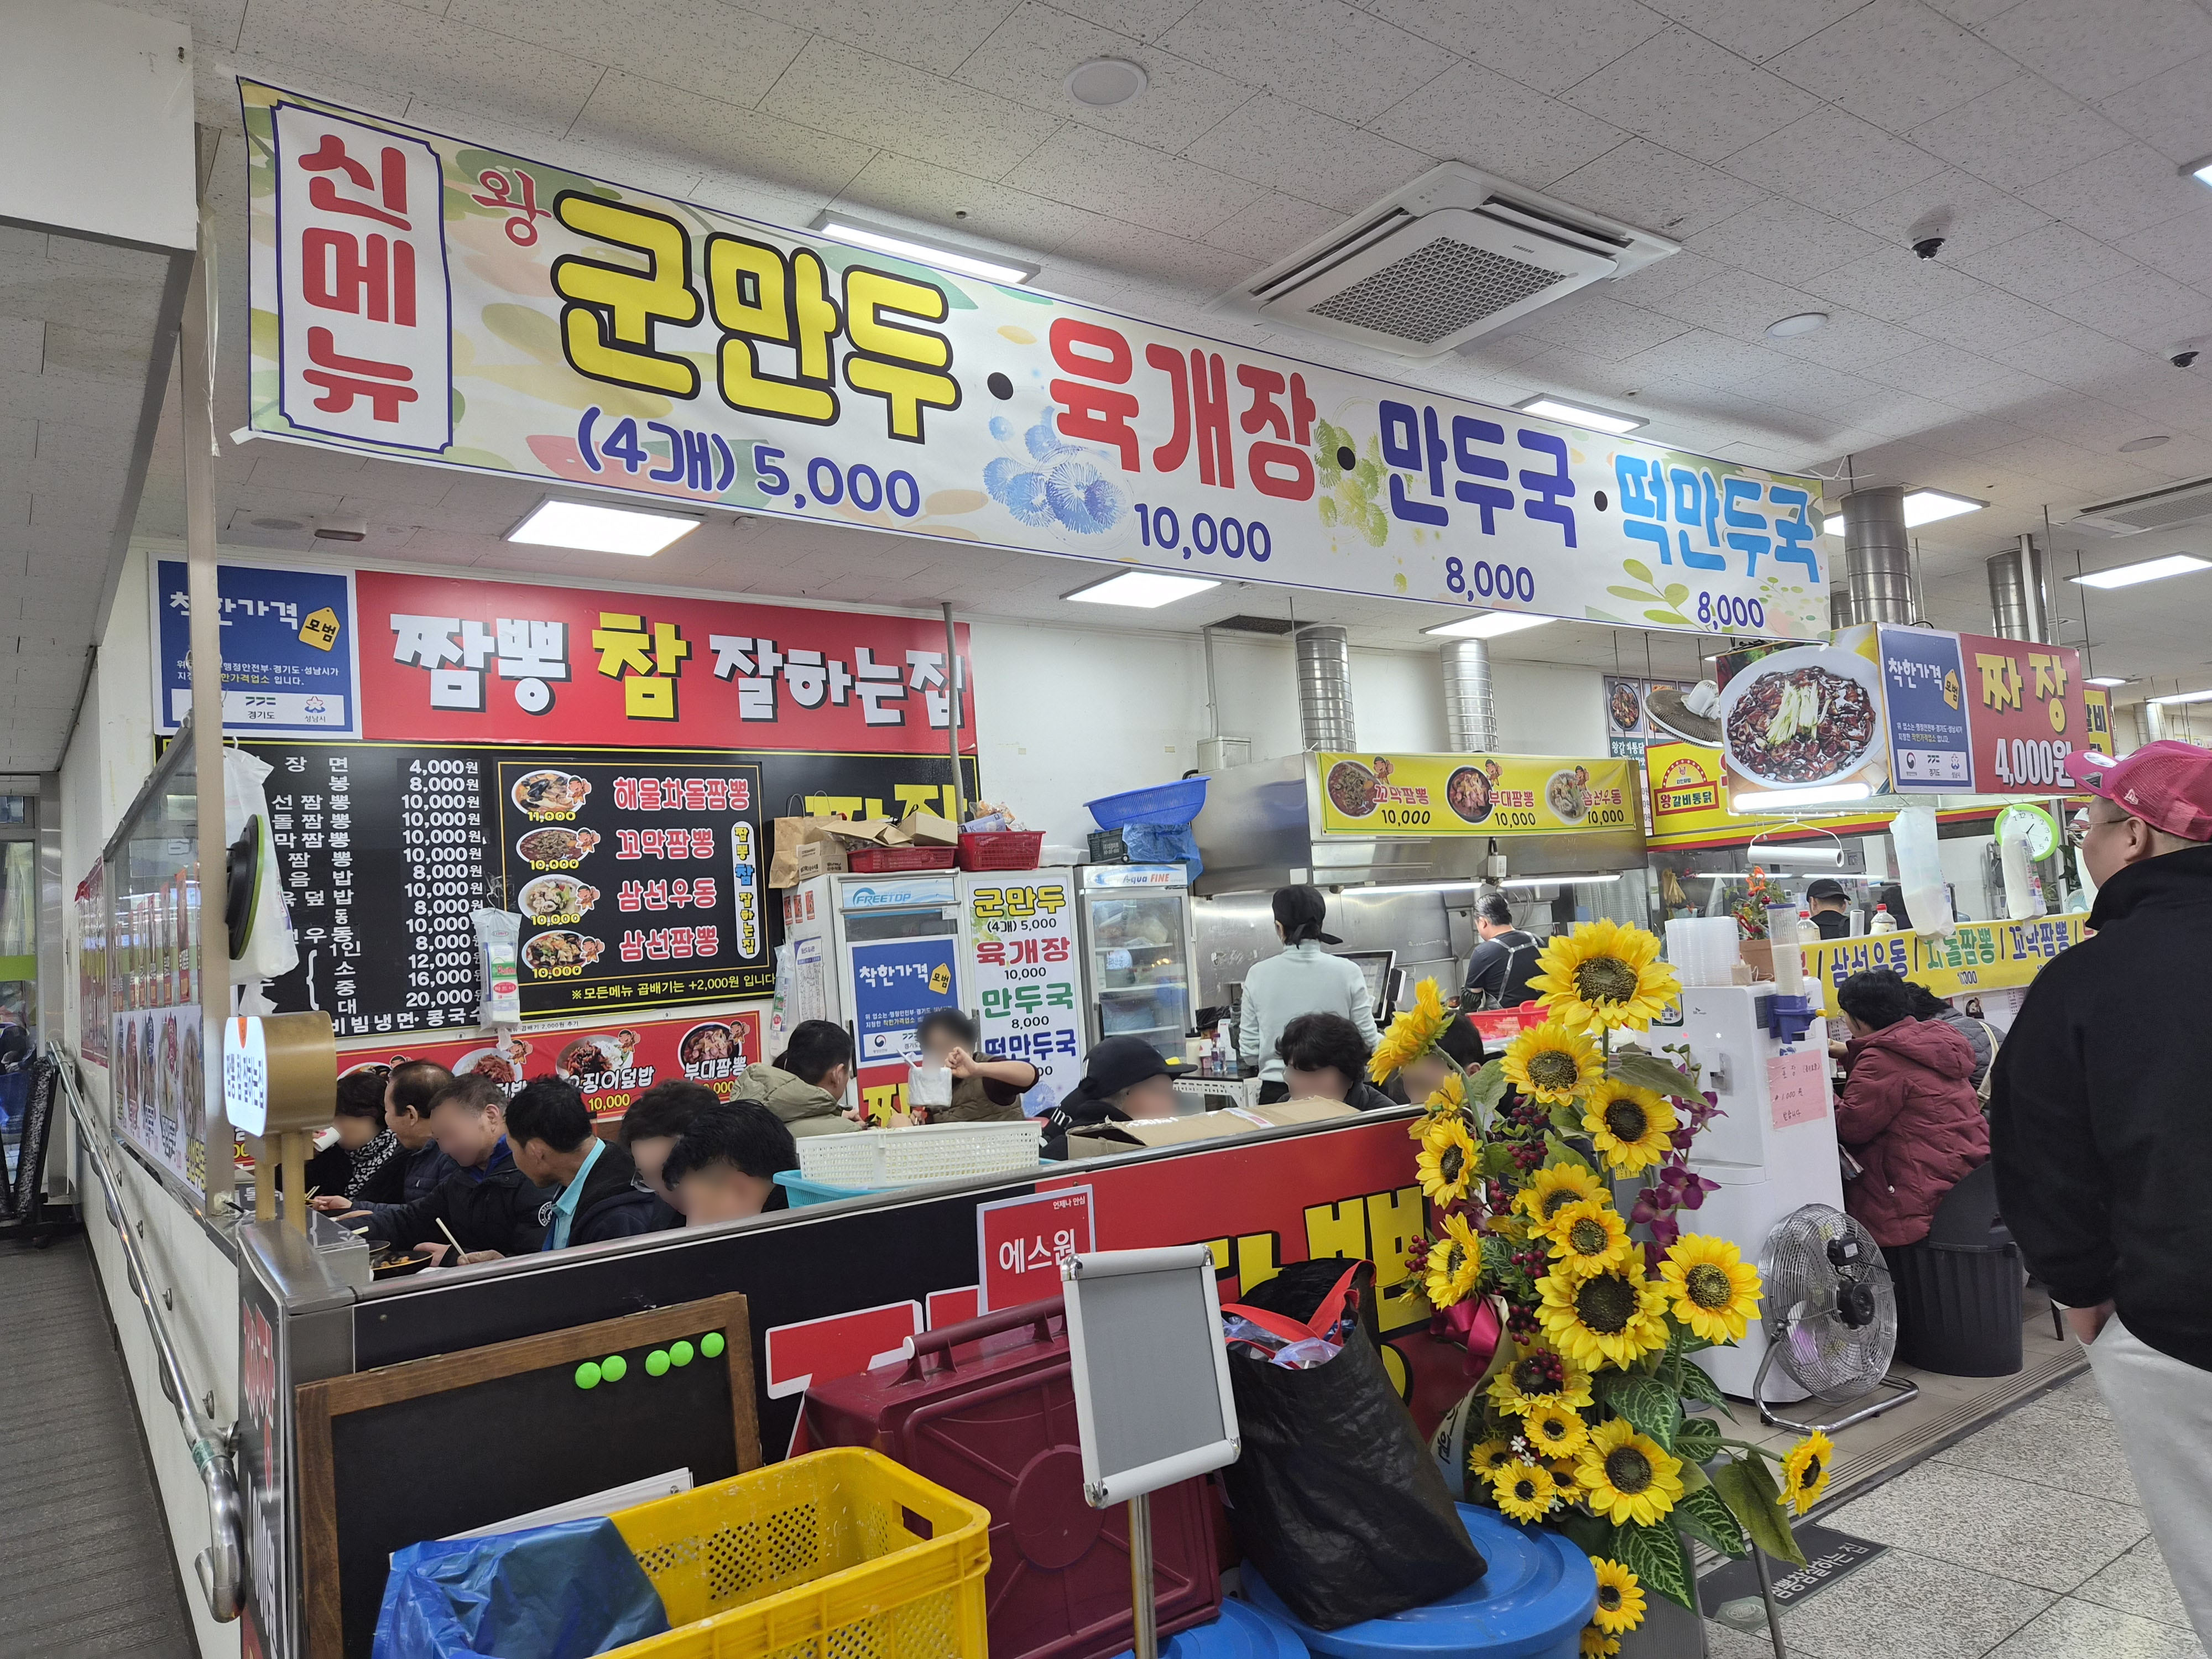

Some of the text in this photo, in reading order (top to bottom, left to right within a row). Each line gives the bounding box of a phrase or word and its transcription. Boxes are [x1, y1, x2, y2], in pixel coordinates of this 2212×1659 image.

[298, 134, 419, 423] 신메뉴
[471, 170, 962, 444] 왕 군만두
[1049, 317, 1318, 502] 육개장
[577, 406, 920, 518] (4개) 5,000
[1379, 399, 1578, 548] 만두국
[1614, 453, 1821, 584] 떡만두국
[1133, 502, 1272, 563] 10,000
[1444, 556, 1535, 603] 8,000
[1697, 590, 1764, 629] 8,000
[305, 618, 336, 643] 모범
[390, 613, 567, 713] 짬뽕
[592, 612, 689, 719] 참
[1888, 658, 1943, 691] 착한가격
[1944, 678, 1959, 702] 모범
[248, 711, 275, 719] 경기도
[409, 759, 478, 776] 4,000원
[409, 776, 479, 794] 8,000원
[613, 776, 750, 811] 해물차돌짬뽕
[401, 794, 479, 811] 10,000원
[1373, 784, 1429, 806] 꼬막짬뽕
[1489, 790, 1534, 808] 부대짬뽕
[1582, 789, 1623, 808] 삼선우동
[1661, 791, 1712, 808] 왕갈비통닭
[402, 812, 480, 828] 10,000원
[526, 811, 576, 822] 11,000
[1381, 808, 1431, 827] 10,000
[1495, 812, 1536, 828] 10,000
[1587, 809, 1624, 827] 10,000
[403, 830, 481, 846] 10,000원
[616, 828, 716, 860] 꼬막짬뽕
[404, 847, 482, 863] 10,000원
[529, 859, 579, 870] 10,000
[413, 864, 482, 881] 8,000원
[1150, 874, 1170, 883] FINE
[405, 882, 483, 898] 10,000원
[617, 878, 717, 912] 삼선우동
[856, 893, 911, 906] FREETOP
[973, 885, 1066, 918] 군만두
[530, 914, 581, 926] 10,000
[987, 918, 1057, 933] (4개) 5,000
[619, 925, 719, 962] 삼선짬뽕
[977, 936, 1070, 966] 육개장
[532, 966, 582, 979] 10,000
[859, 963, 928, 988] 착한가격
[932, 972, 950, 989] 모범
[1004, 967, 1046, 982] 10,000
[335, 979, 357, 997] 중
[638, 981, 684, 995] 곱배기는
[688, 975, 739, 992] +2,000원
[338, 998, 357, 1014] 대
[982, 982, 1073, 1019] 만두국
[1011, 1016, 1050, 1030] 8,000
[684, 1056, 747, 1081] 부대짬뽕
[588, 1093, 630, 1112] 10,000
[1053, 1196, 1086, 1210] 언제나 안심
[999, 1228, 1076, 1275] 에스원
